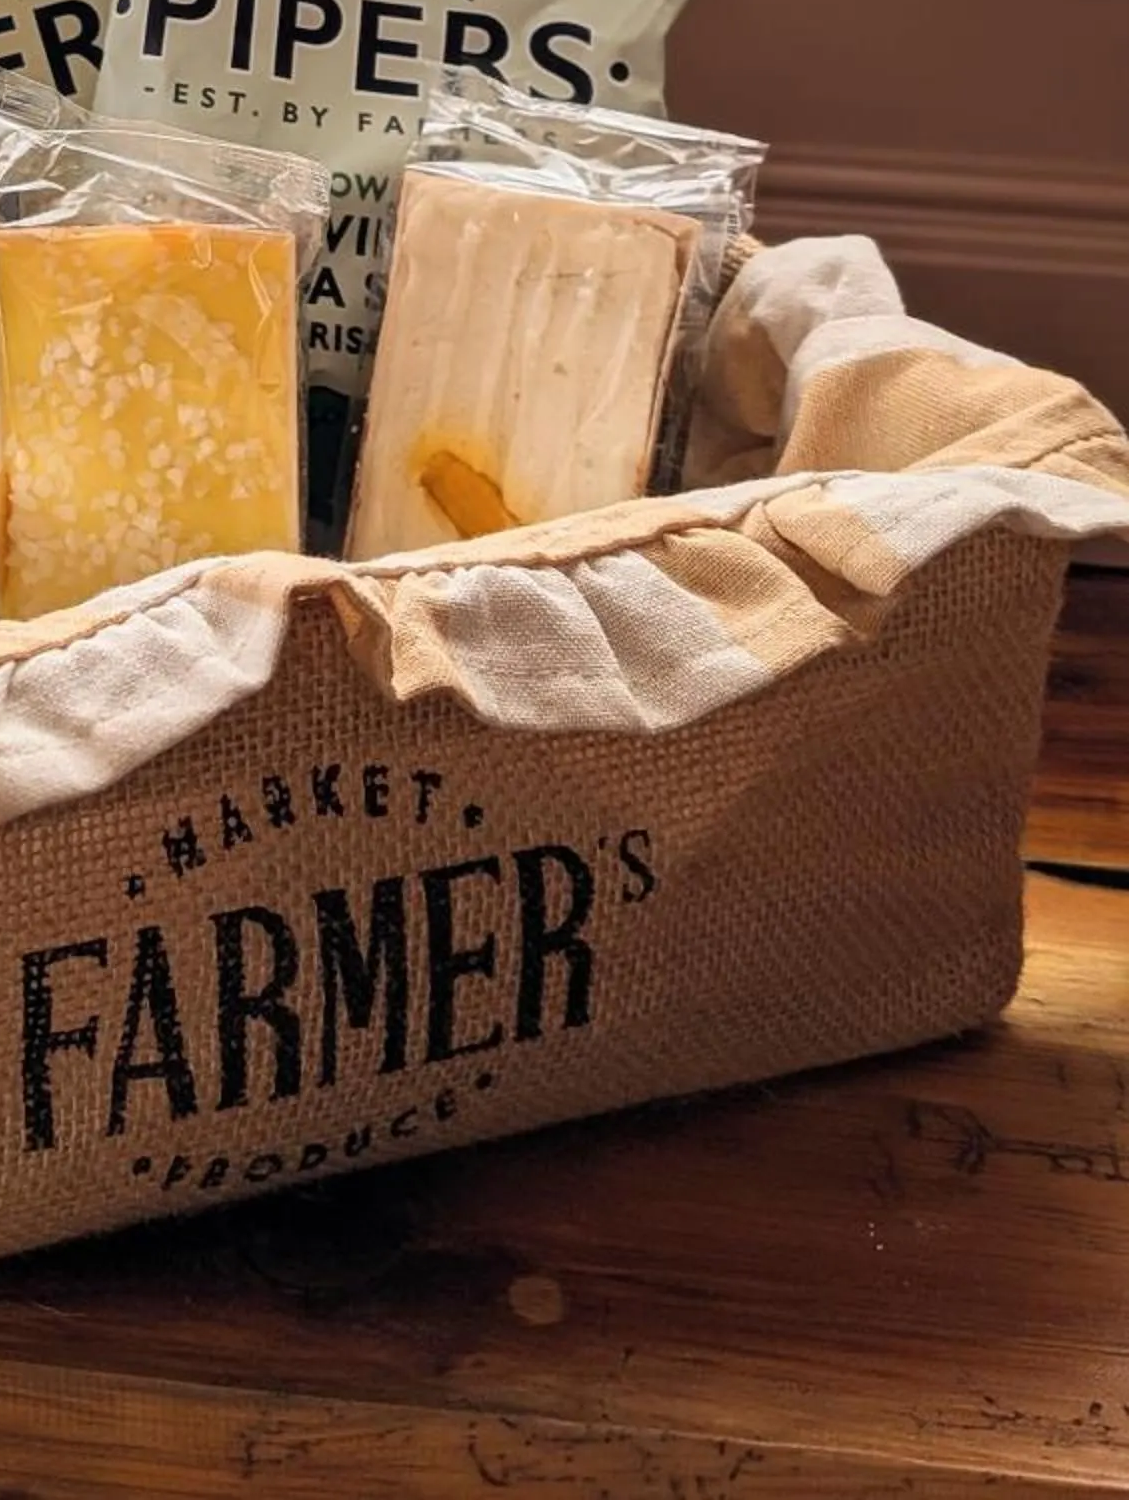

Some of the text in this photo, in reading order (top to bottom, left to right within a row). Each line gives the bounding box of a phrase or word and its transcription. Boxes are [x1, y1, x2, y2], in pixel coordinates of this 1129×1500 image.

[282, 102, 330, 128] BY
[20, 829, 656, 1152] FARMER'S
[161, 1088, 457, 1191] PRODUCE
